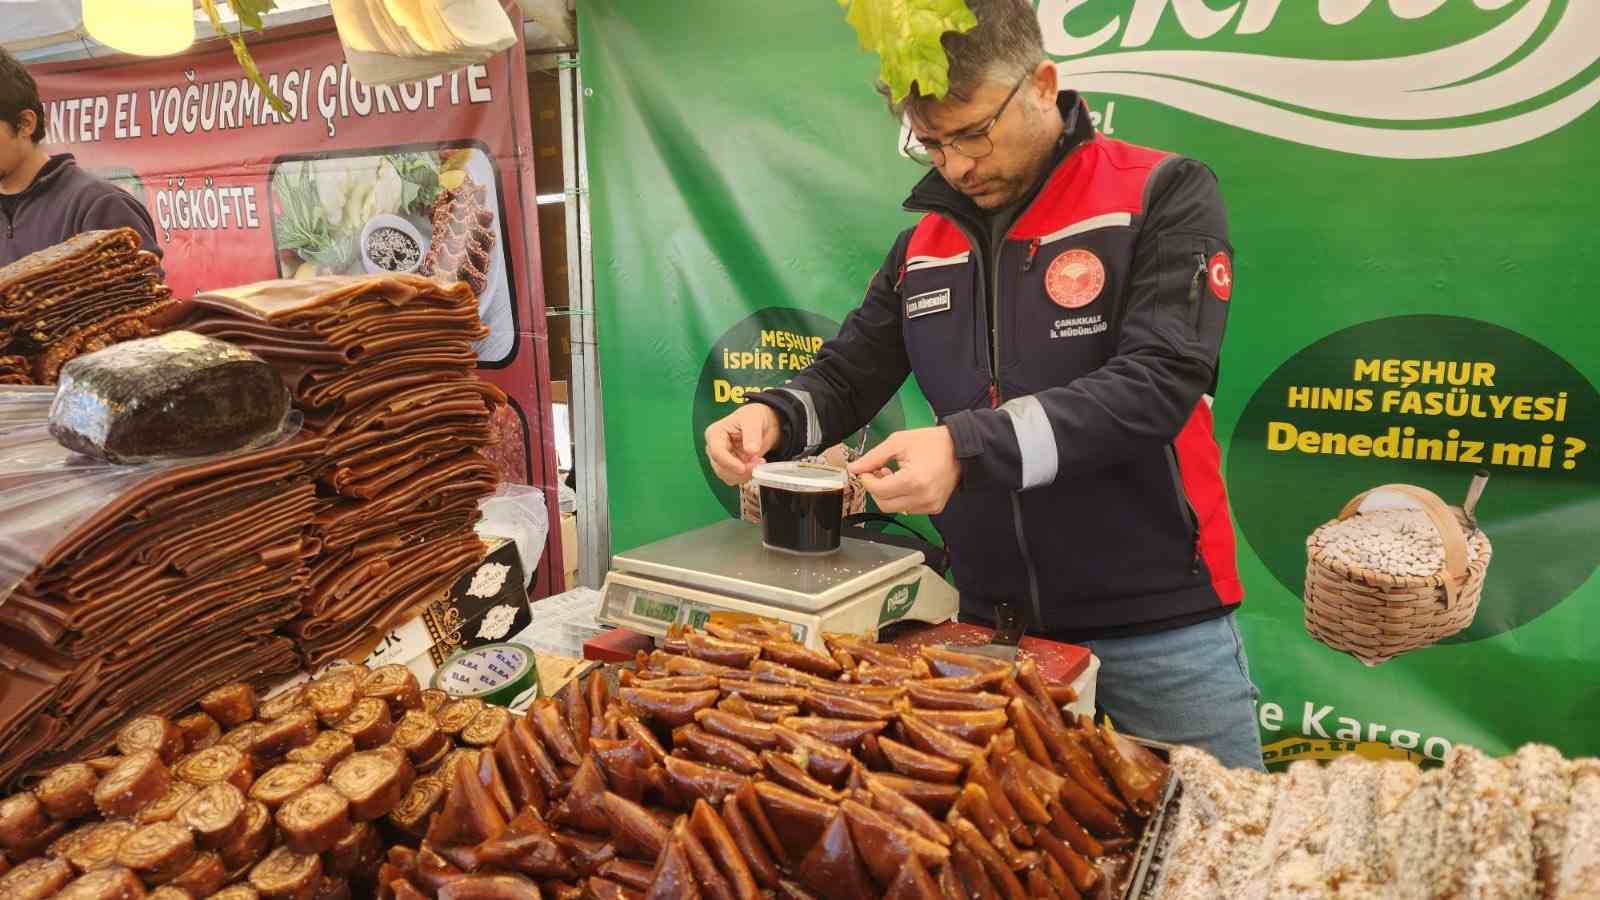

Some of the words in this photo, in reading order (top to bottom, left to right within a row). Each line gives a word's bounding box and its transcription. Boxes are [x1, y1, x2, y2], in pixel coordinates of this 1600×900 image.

[114, 93, 141, 139] EL
[150, 68, 312, 136] YOĞURMASI
[157, 176, 259, 241] ÇİĞKÖFTE
[723, 348, 773, 369] İSPİR
[1354, 359, 1496, 388] MEŞHUR
[1288, 386, 1374, 412] HINIS
[1381, 388, 1568, 422] FASÜLYESİ
[1267, 421, 1485, 464] Denediniz
[1491, 434, 1554, 468] mi
[1562, 437, 1586, 470] ?
[1302, 701, 1452, 763] Kargo
